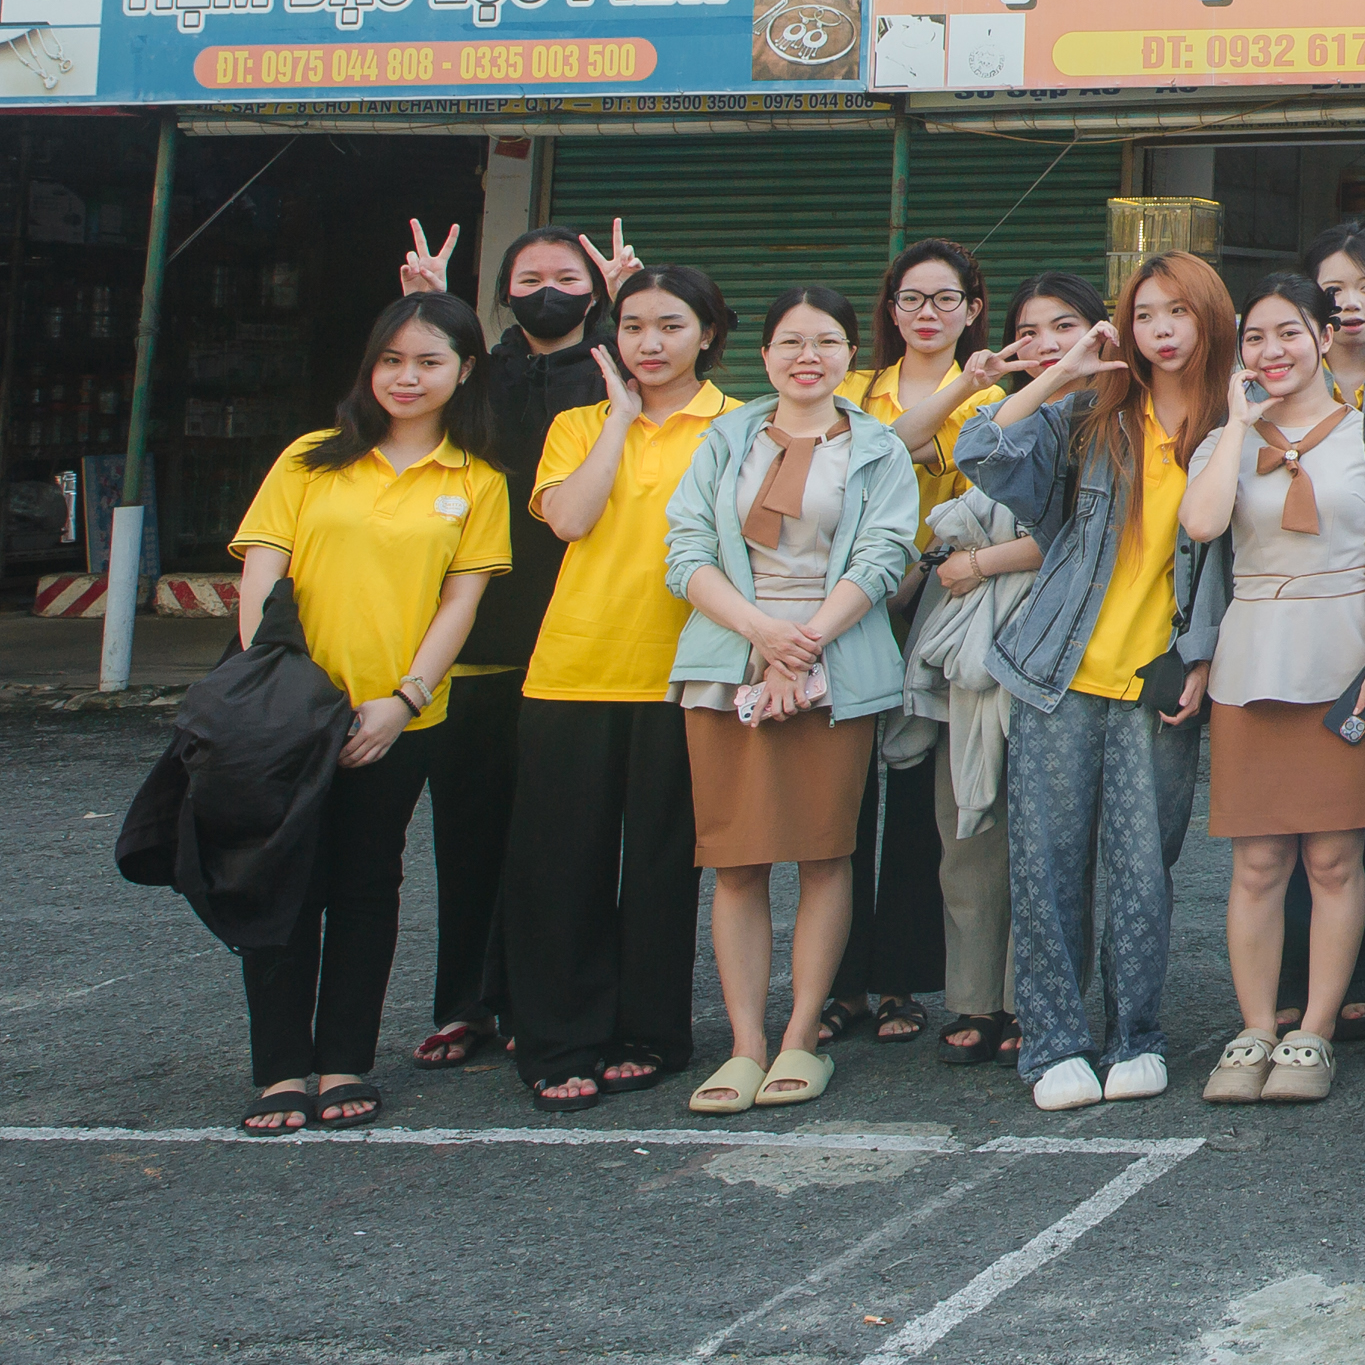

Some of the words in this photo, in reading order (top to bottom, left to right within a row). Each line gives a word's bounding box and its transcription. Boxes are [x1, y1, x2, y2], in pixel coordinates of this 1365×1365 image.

[215, 47, 254, 84] ĐT:
[261, 46, 327, 83] 0975
[332, 45, 381, 82] 044
[387, 43, 435, 81] 808
[460, 43, 524, 79] 0335
[530, 42, 580, 78] 003
[587, 41, 636, 77] 500
[1141, 35, 1193, 70] ĐT:
[1206, 34, 1297, 69] 0932
[636, 96, 656, 111] 03
[661, 95, 701, 111] 3500
[706, 94, 747, 110] 3500
[763, 93, 803, 109] 0975
[808, 93, 839, 109] 044
